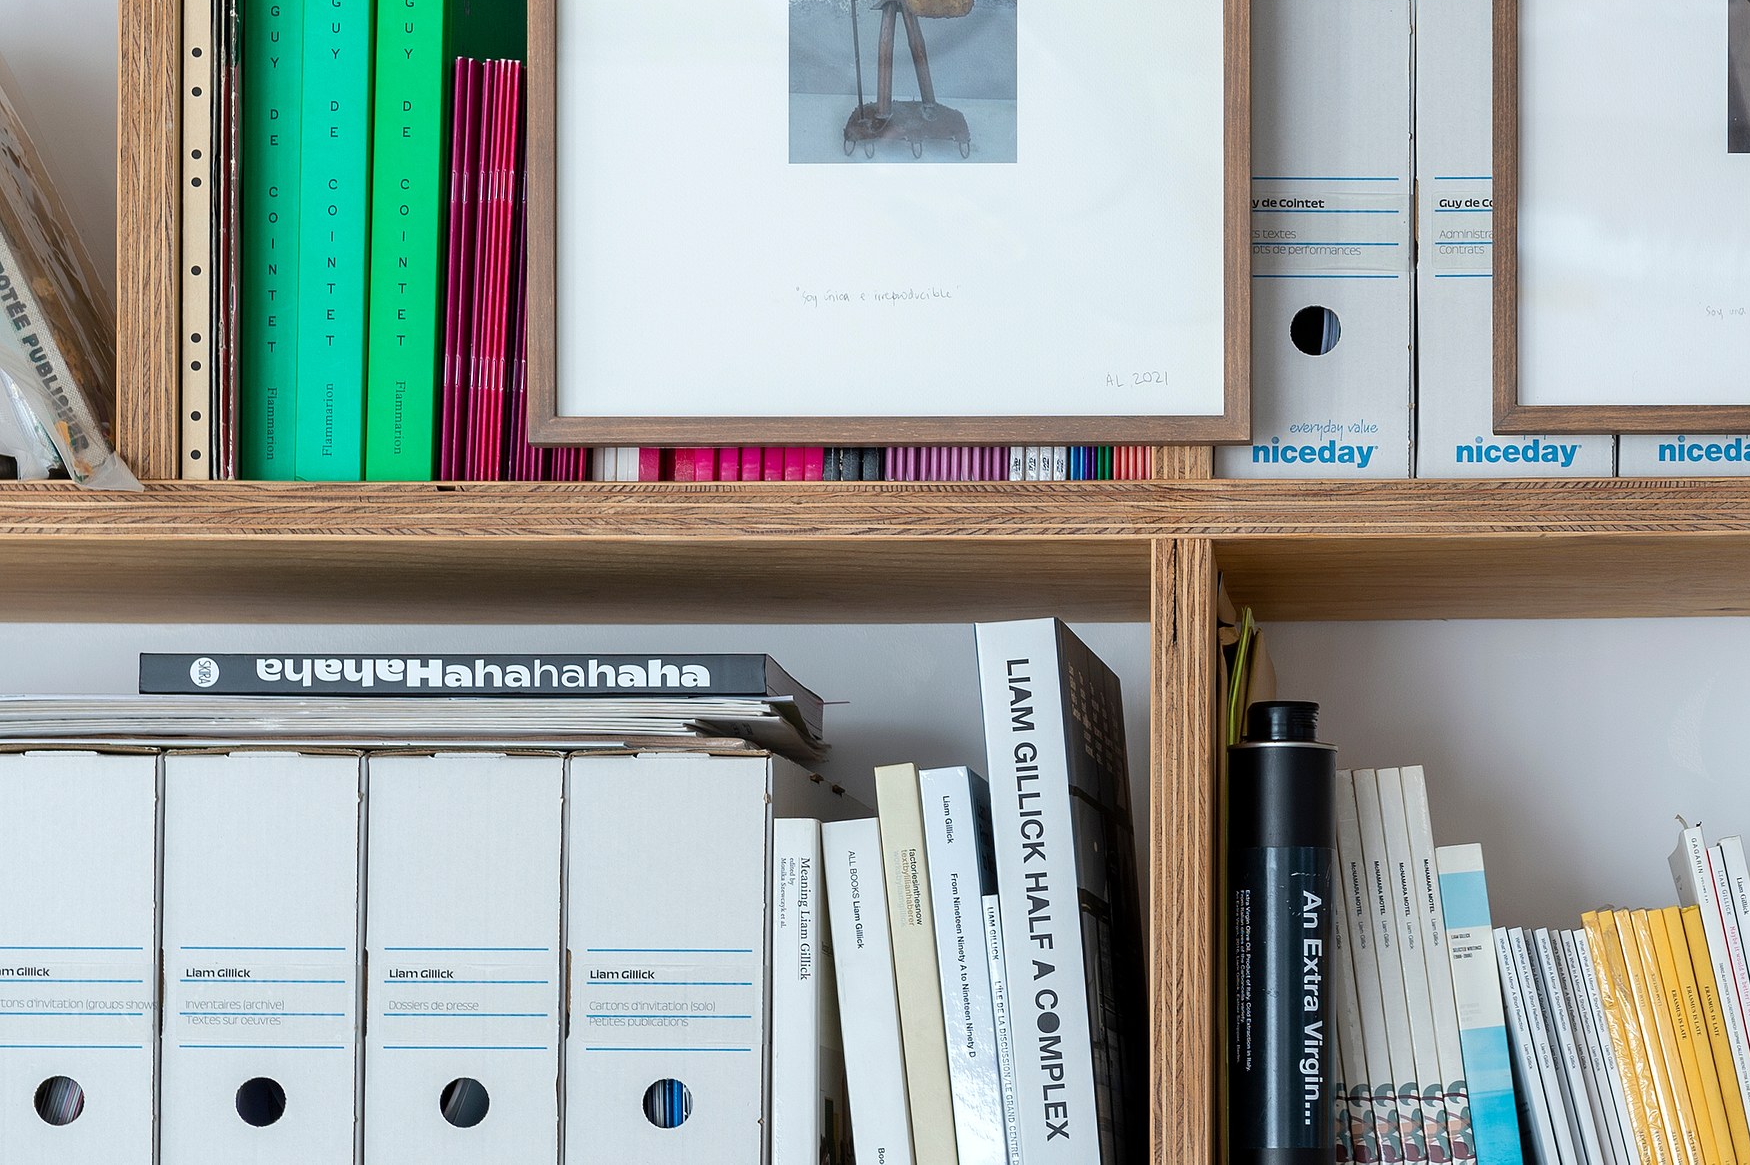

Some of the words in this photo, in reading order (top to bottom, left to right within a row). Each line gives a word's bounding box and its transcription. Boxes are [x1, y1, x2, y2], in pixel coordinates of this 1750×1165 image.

[330, 101, 339, 138] DE
[326, 179, 338, 346] COINTET
[322, 383, 335, 457] Flammarion
[1253, 437, 1374, 467] niceday
[1456, 436, 1577, 466] niceday
[1006, 657, 1035, 732] LIAM
[1012, 742, 1047, 863] GILLICK
[1024, 871, 1053, 951] HALF
[1303, 890, 1322, 929] An
[186, 968, 213, 977] Liam
[217, 968, 250, 977] Gillick
[1031, 959, 1055, 982] A
[1302, 938, 1322, 1013] Extra
[389, 1001, 426, 1010] Dossiers
[429, 1001, 441, 1010] de
[445, 1002, 479, 1013] presse
